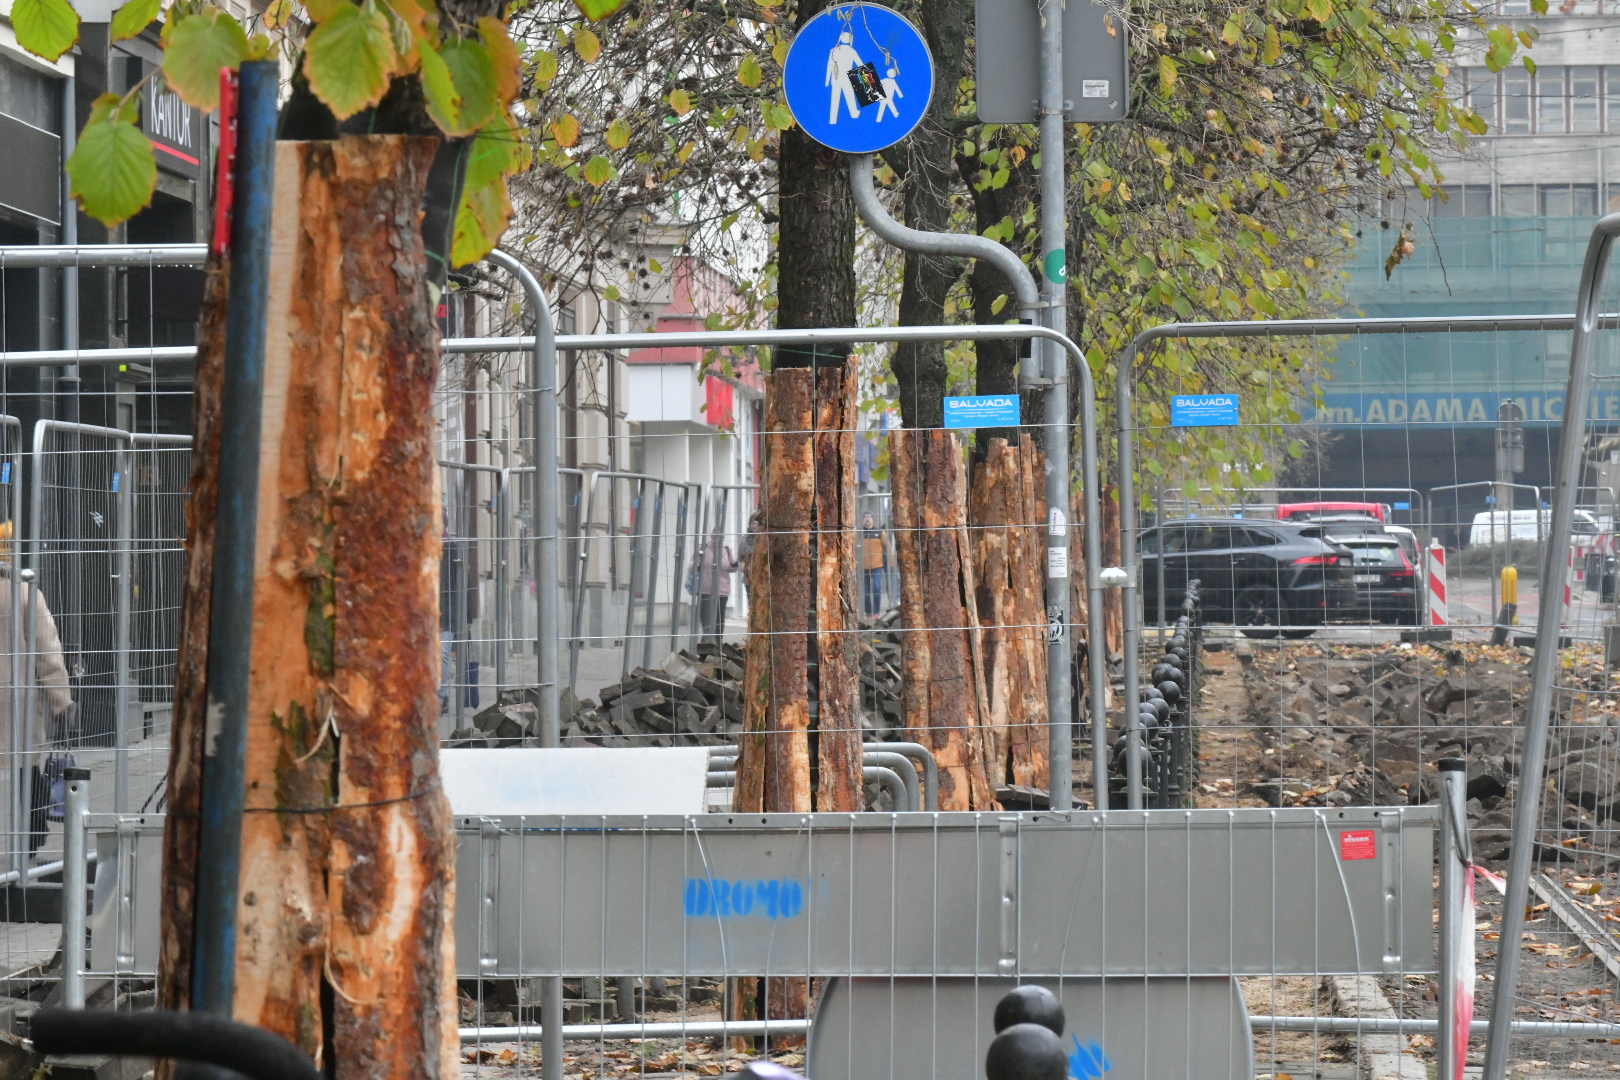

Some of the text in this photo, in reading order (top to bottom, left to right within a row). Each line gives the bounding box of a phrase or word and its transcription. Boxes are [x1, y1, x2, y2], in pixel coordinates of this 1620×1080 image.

[949, 398, 1013, 409] SALVADA
[1176, 398, 1233, 407] SALVADA
[1366, 398, 1488, 423] ADAMA
[1344, 834, 1370, 843] nissen
